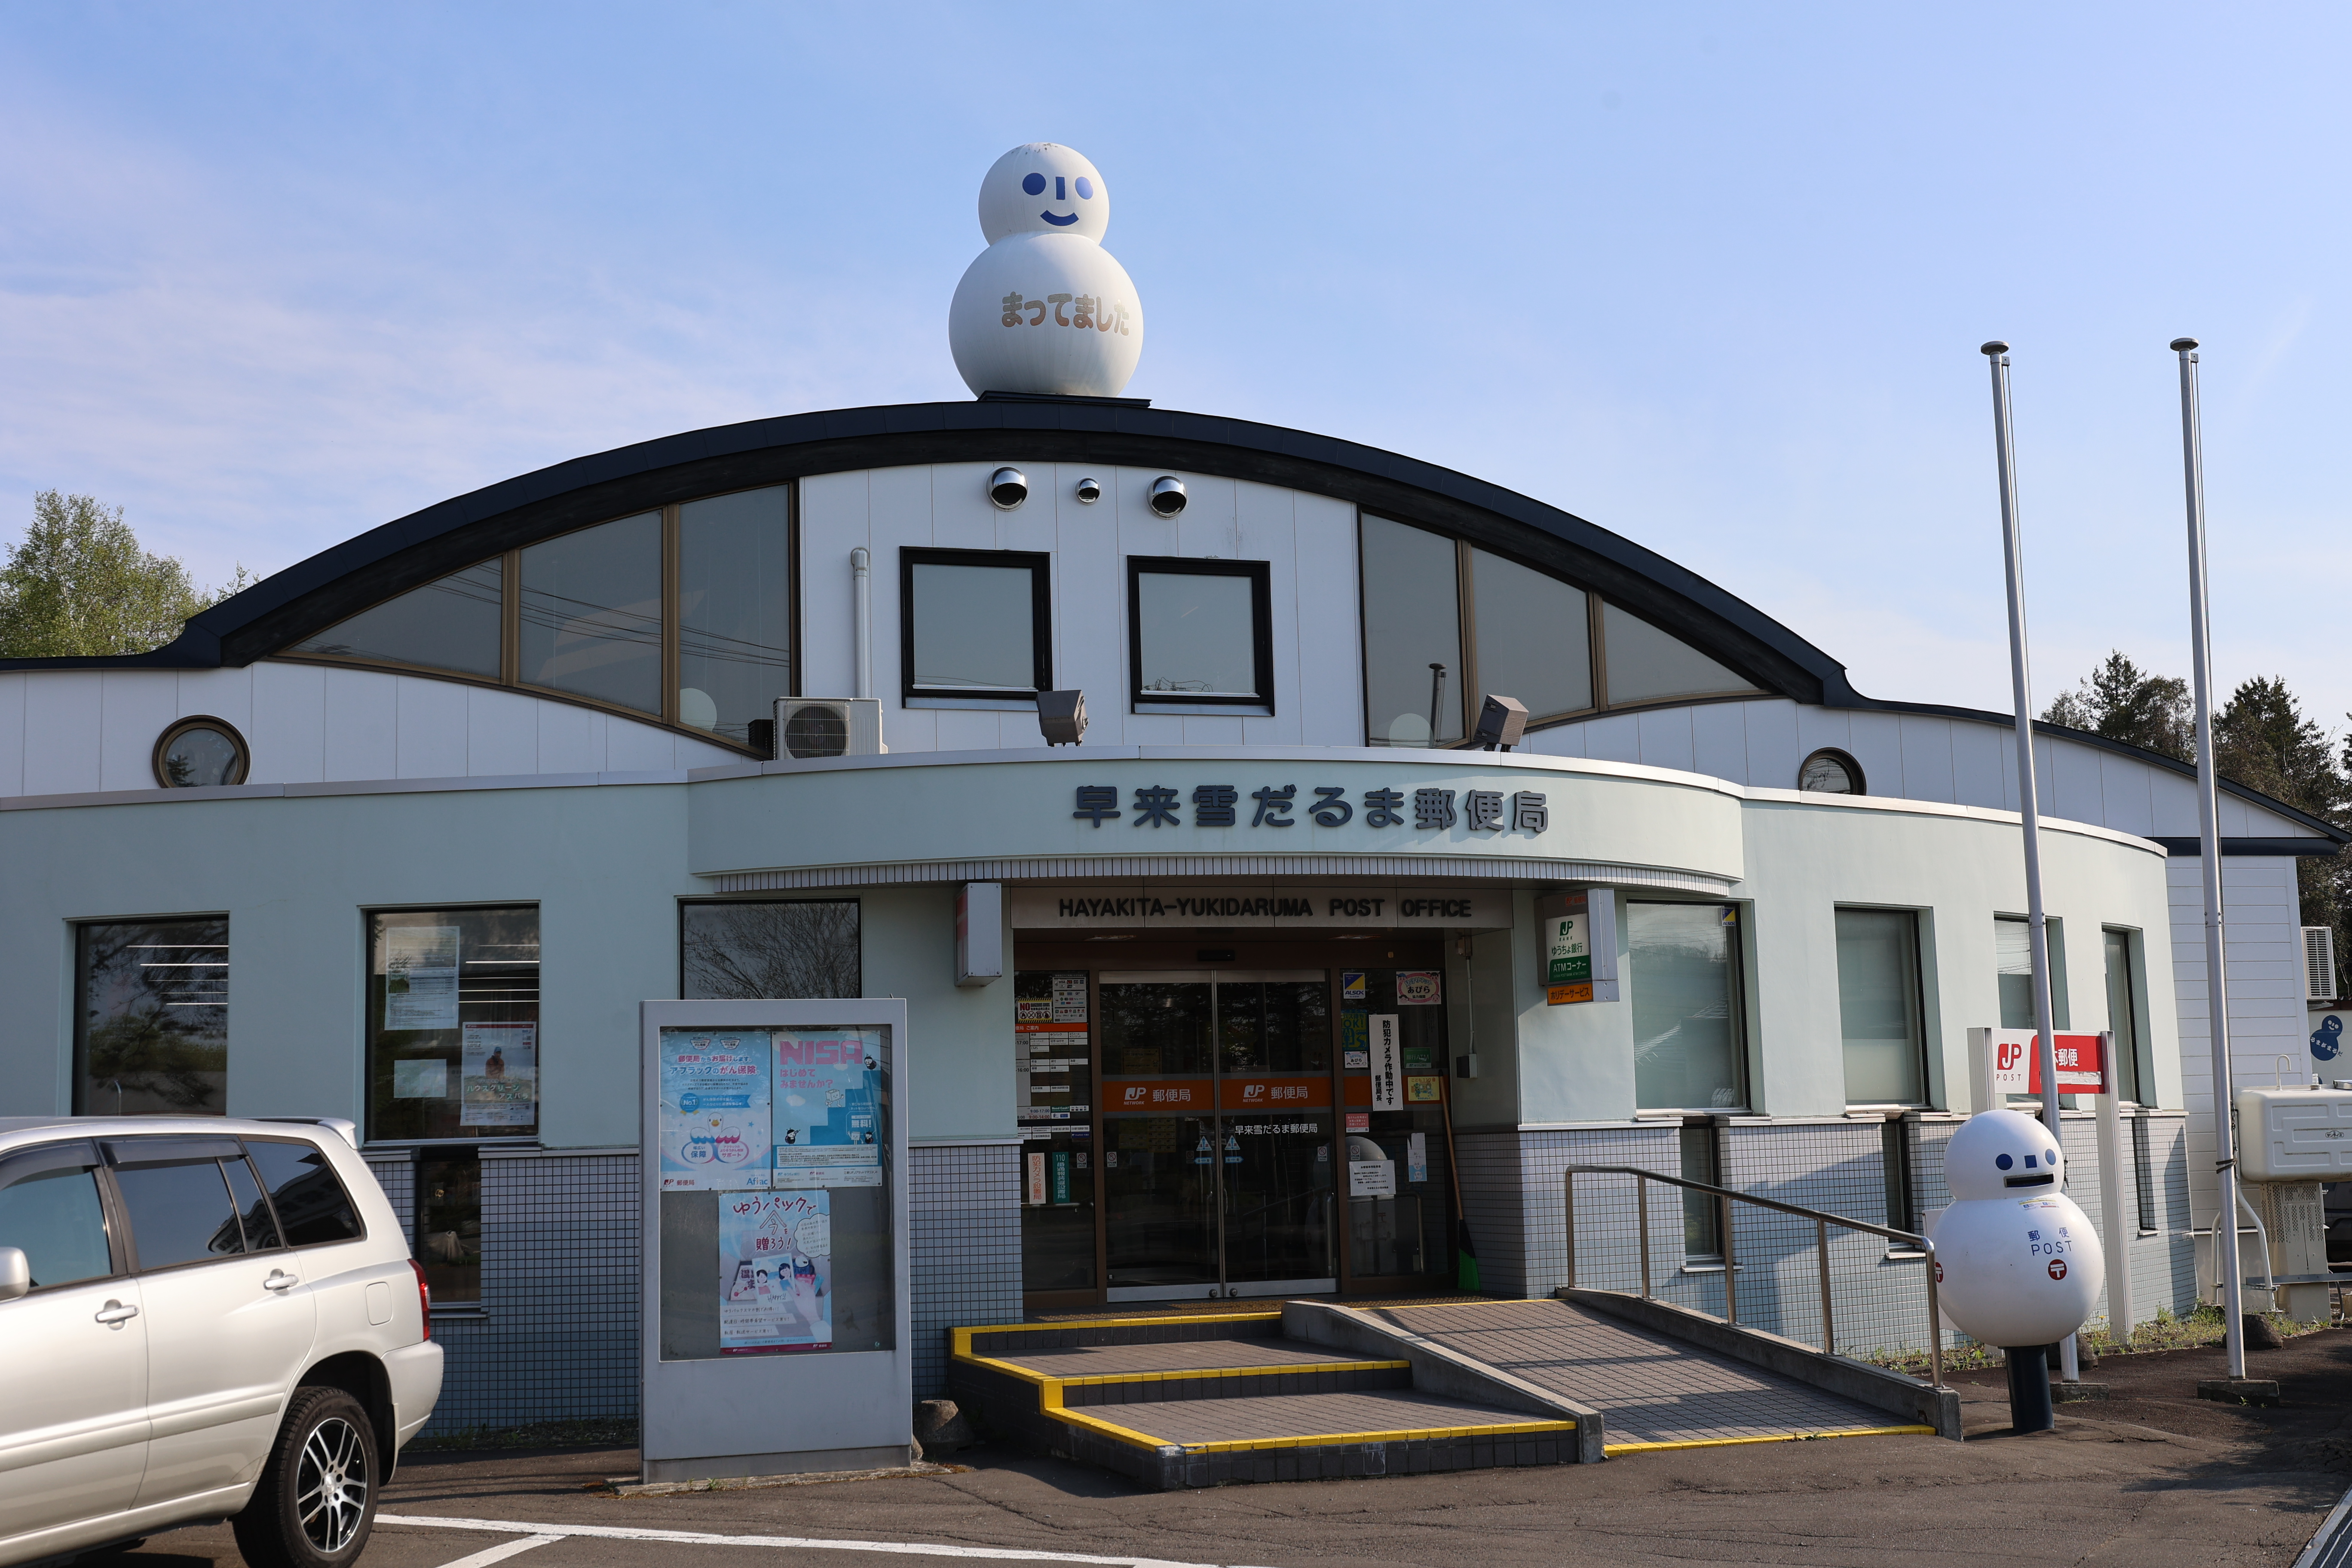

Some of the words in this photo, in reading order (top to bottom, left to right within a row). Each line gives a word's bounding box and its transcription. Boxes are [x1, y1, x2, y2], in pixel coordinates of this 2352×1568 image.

[1001, 291, 1130, 336] まってました
[1072, 784, 1549, 833] 早来雪だるま郵便局
[1059, 897, 1312, 918] HAYAKITA-YUKIDARUMA
[1330, 899, 1385, 917] POST
[1402, 899, 1472, 918] OFFICE
[1559, 921, 1574, 936] JP
[1551, 943, 1583, 956] ゆうちょ銀行
[1553, 960, 1587, 972] ATMコーナー
[1404, 977, 1433, 987] 見守りネット
[1550, 987, 1590, 1001] ホリデーサービス
[1020, 1003, 1030, 1011] NO
[1343, 1019, 1363, 1028] OK!
[678, 1055, 752, 1063] 郵便局からお届けします。
[779, 1040, 863, 1065] NISA
[1997, 1043, 2022, 1070] JP
[670, 1065, 760, 1075] アフラックのがん保険。
[1382, 1020, 1394, 1106] 防犯カメラ作動中です
[780, 1069, 816, 1078] はじめて
[467, 1084, 520, 1092] ハウスグリーン
[779, 1079, 833, 1089] みませんか?
[1124, 1087, 1147, 1100] JP
[1152, 1089, 1191, 1102] 郵便局
[1243, 1085, 1265, 1098] JP
[1270, 1086, 1308, 1100] 郵便局
[1234, 1123, 1318, 1136] 早来雪だるま郵便局
[690, 1151, 707, 1159] 保障
[746, 1177, 768, 1185] Aflac
[1032, 1155, 1041, 1200] 防犯カメラ設置局
[1056, 1154, 1066, 1199] 110番通報装置設置局
[733, 1196, 817, 1216] ゆうパックで
[2027, 1226, 2070, 1243] 郵便
[2030, 1240, 2073, 1256] POST
[767, 1293, 786, 1303] HAPPY!!
